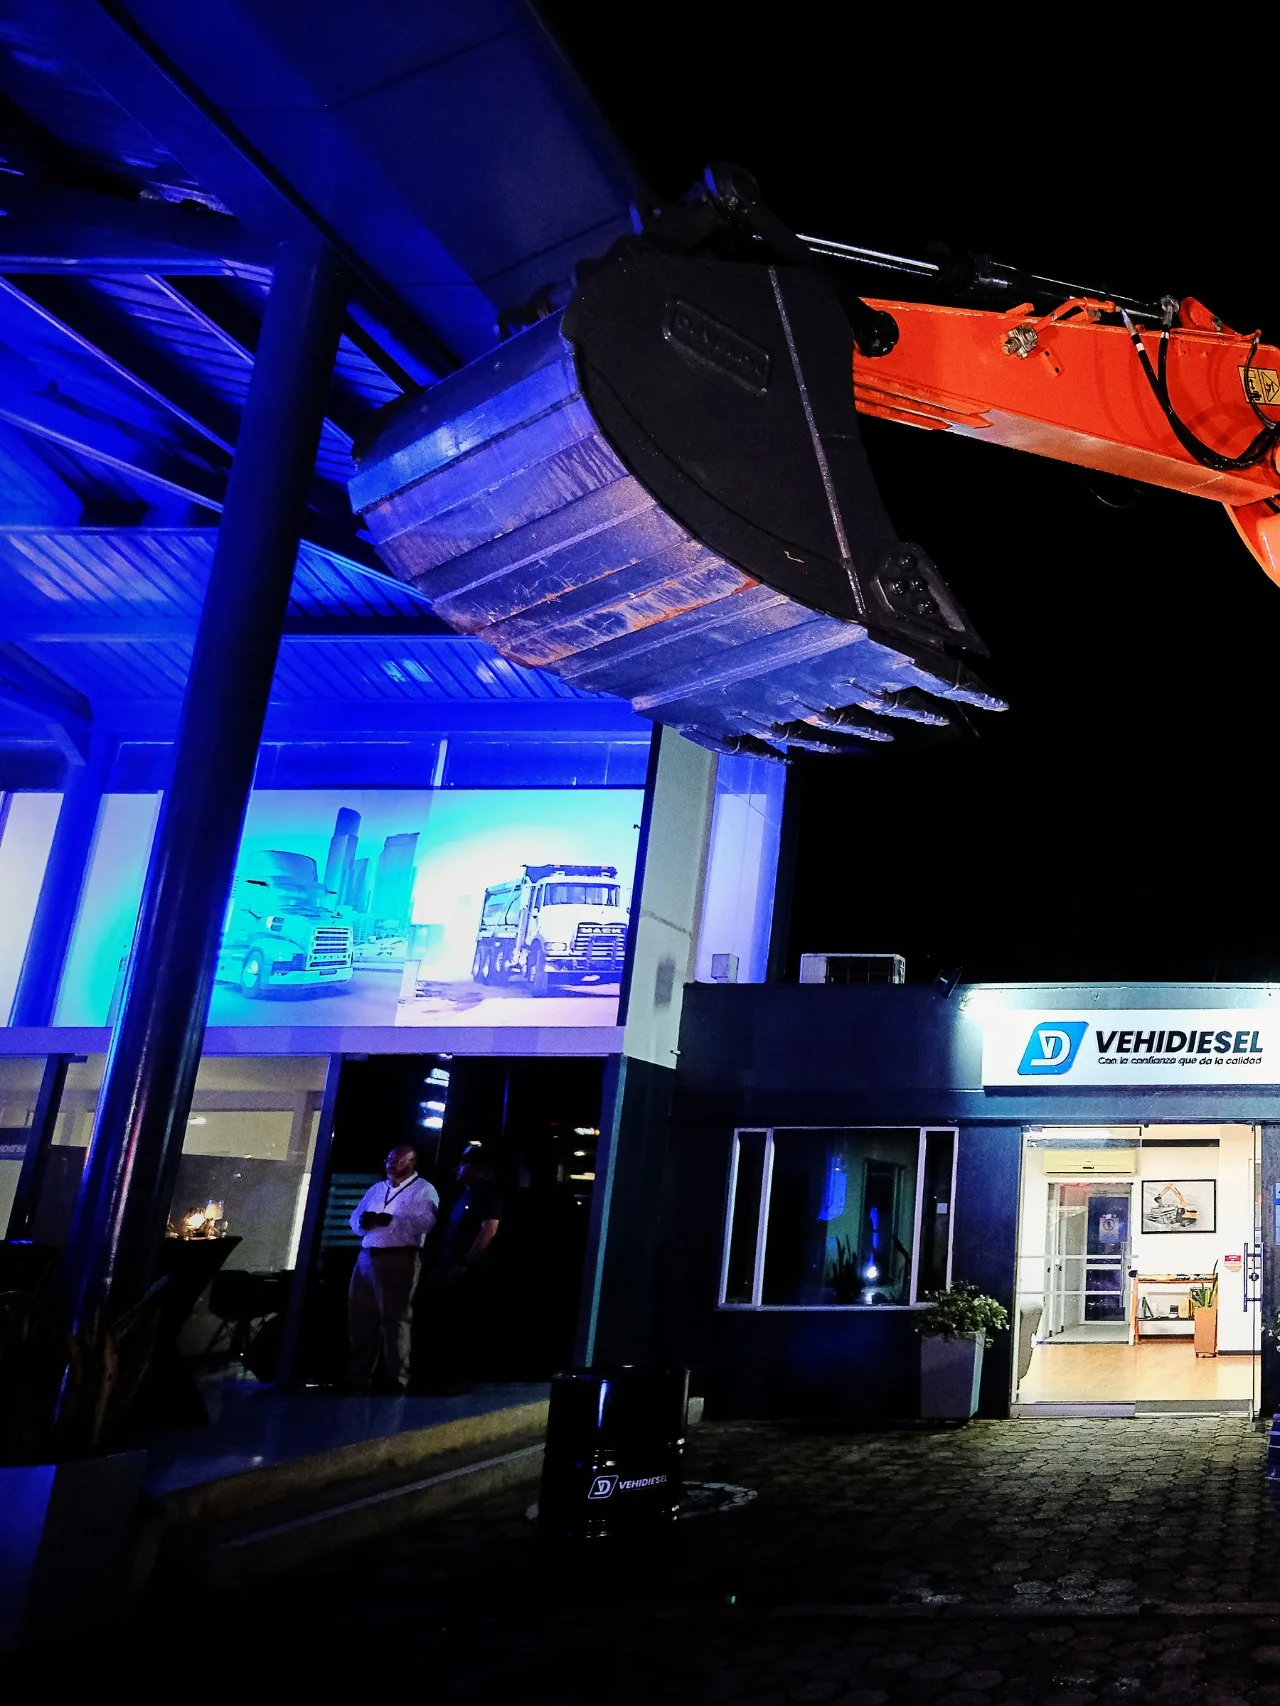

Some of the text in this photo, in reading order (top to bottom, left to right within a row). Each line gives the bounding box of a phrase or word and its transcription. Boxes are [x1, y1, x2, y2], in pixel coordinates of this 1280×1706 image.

[1096, 1030, 1263, 1054] VEHIDIESEL
[1098, 1056, 1262, 1067] Con la confianza que da la calidad
[619, 1475, 667, 1489] VEHIDIESEL
